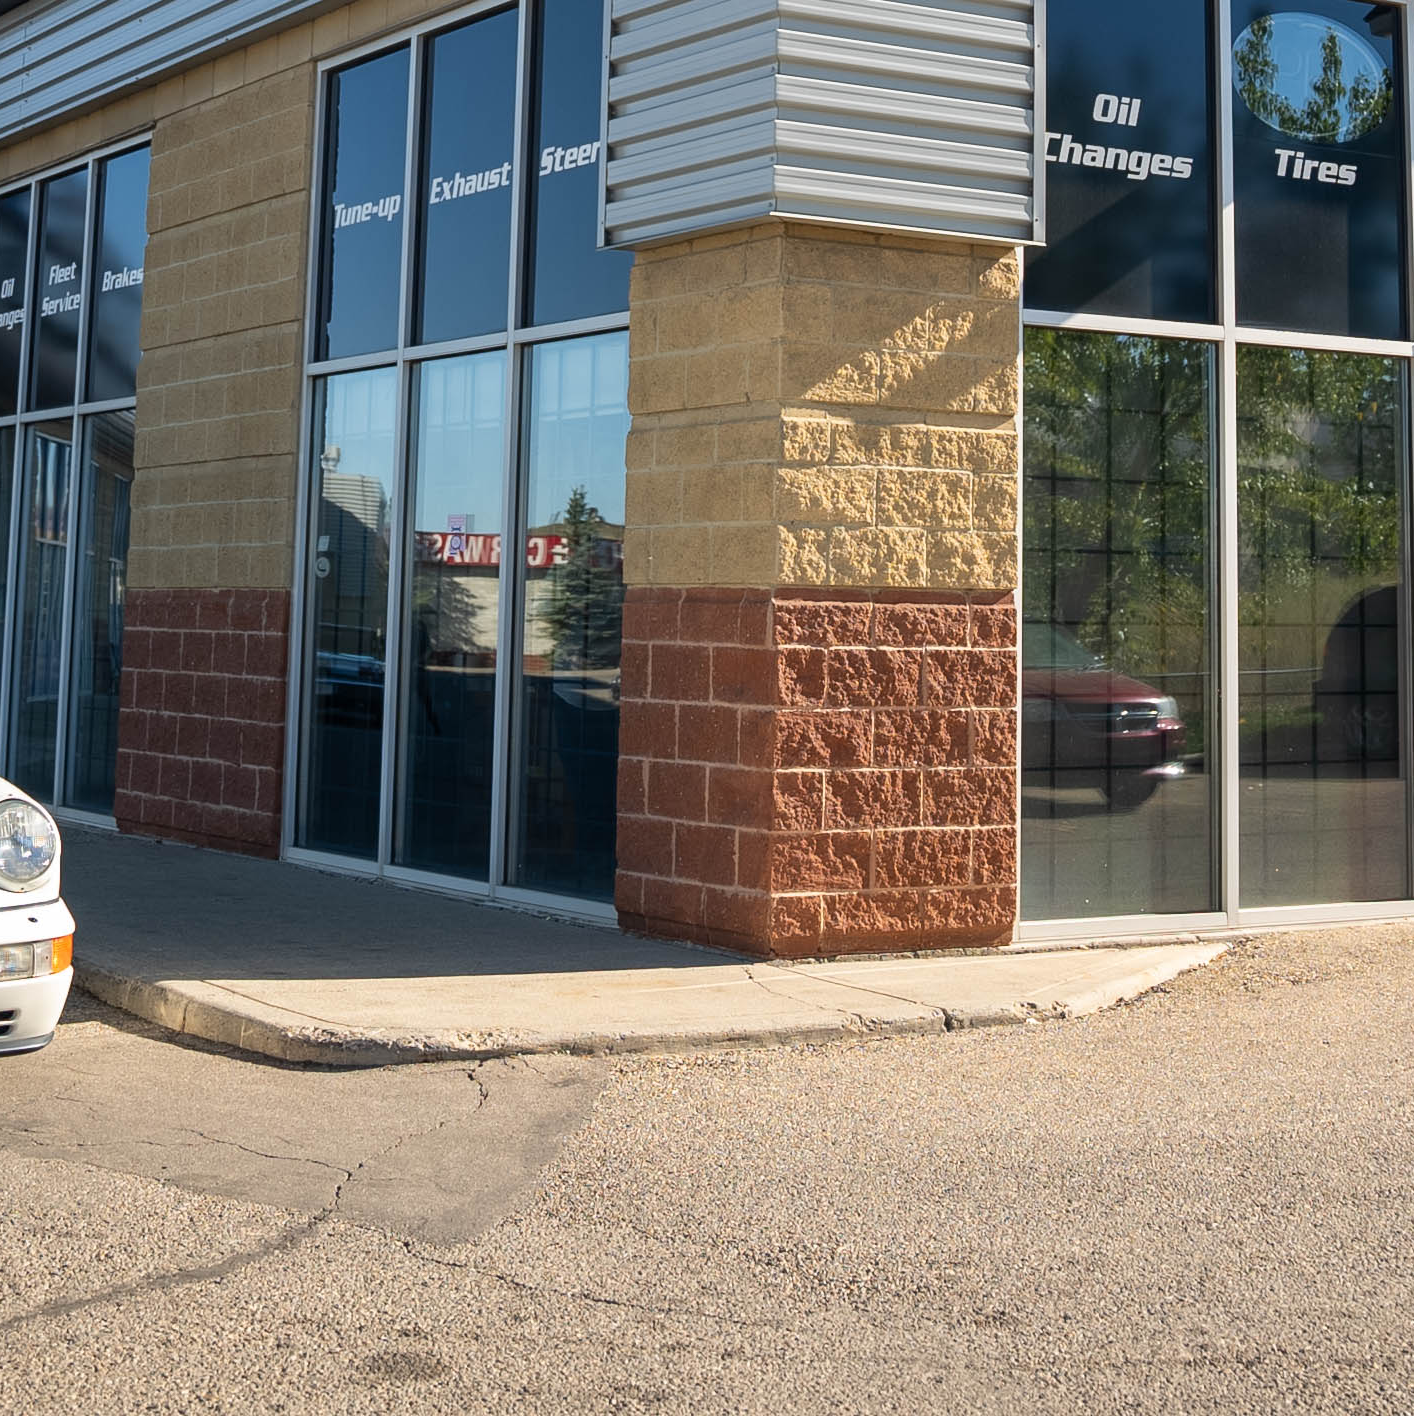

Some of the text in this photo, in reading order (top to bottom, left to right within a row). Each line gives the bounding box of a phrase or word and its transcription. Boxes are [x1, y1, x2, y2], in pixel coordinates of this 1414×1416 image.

[1093, 93, 1141, 127] Oil
[539, 141, 600, 177] Steer
[1044, 131, 1194, 181] Changes
[1274, 148, 1358, 186] Tires
[430, 162, 512, 204] Exhaust
[335, 194, 401, 229] Tune-up
[1, 278, 15, 299] Oil
[49, 262, 77, 286] Fleet
[102, 267, 144, 292] Brakes
[41, 292, 81, 317] Service
